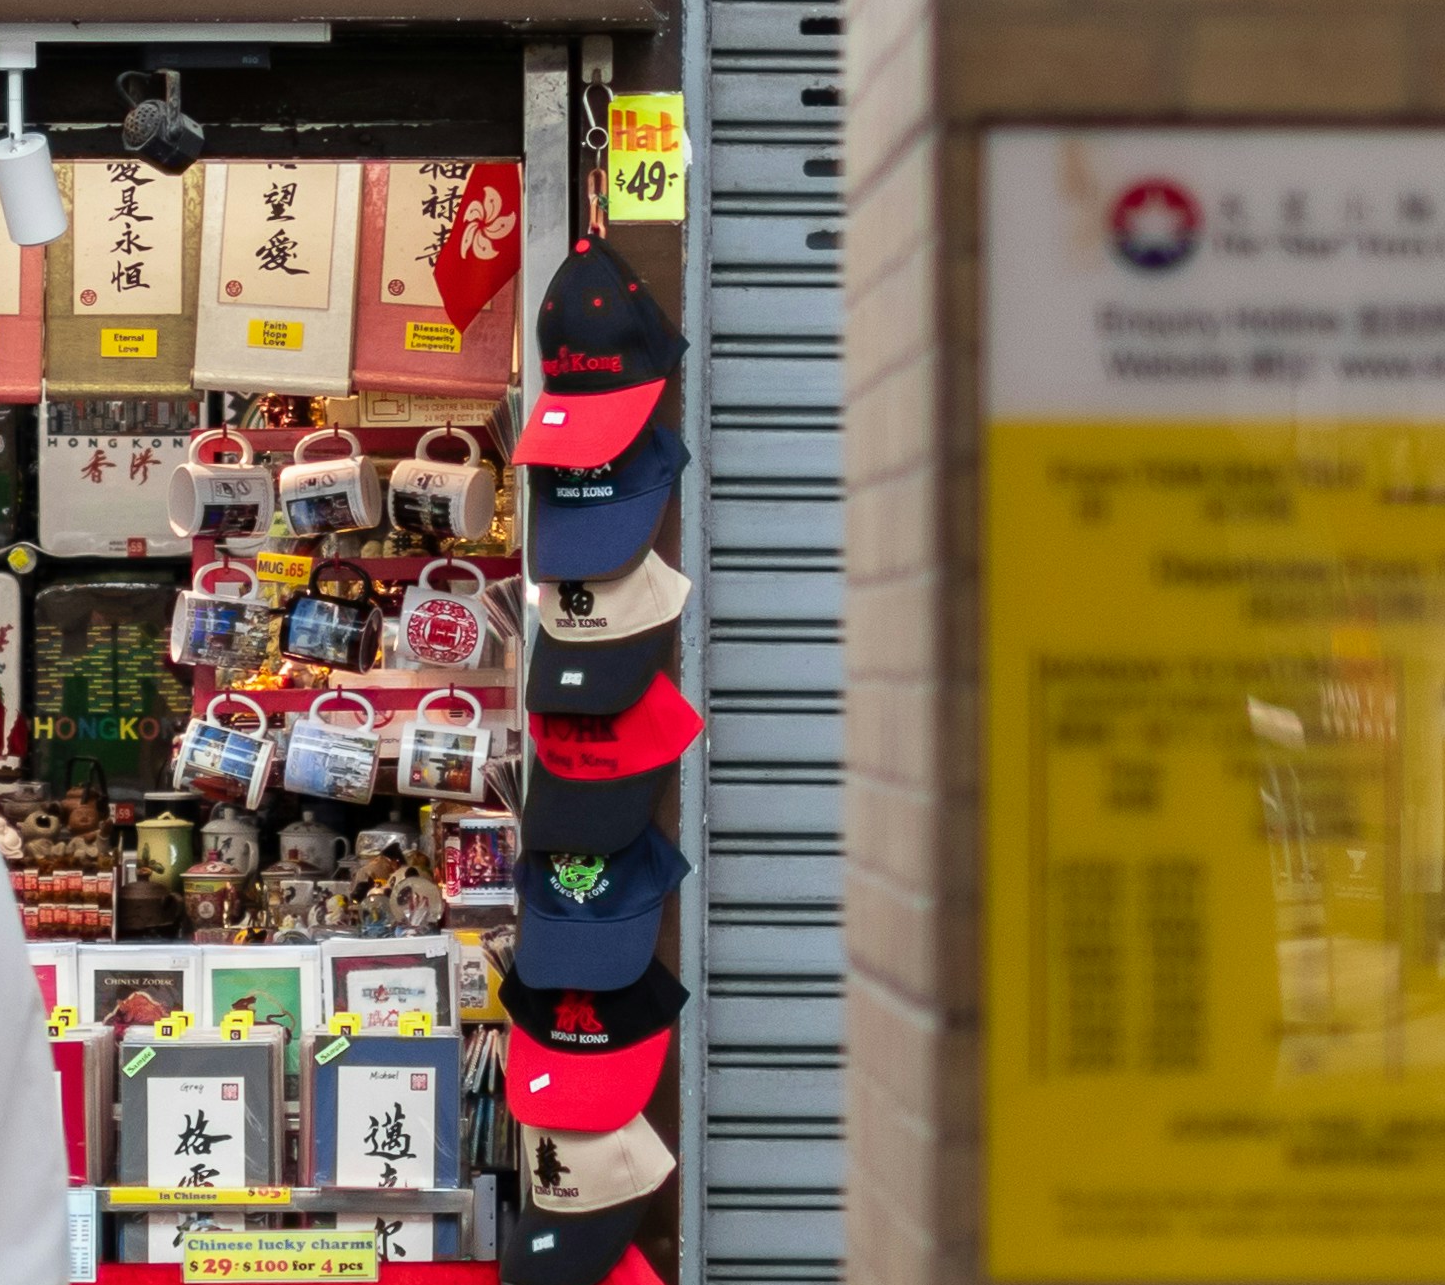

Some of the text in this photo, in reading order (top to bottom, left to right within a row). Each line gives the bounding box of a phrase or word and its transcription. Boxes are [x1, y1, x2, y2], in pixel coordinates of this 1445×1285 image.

[611, 109, 680, 153] Hat
[256, 162, 310, 276] 望愛
[263, 321, 288, 331] Faith
[413, 324, 455, 335] Blessing
[113, 333, 145, 342] Eternal
[262, 330, 287, 340] Hope
[412, 333, 455, 343] Prosperity
[262, 338, 286, 347] Love
[410, 342, 456, 352] Longevity
[118, 345, 139, 353] Love
[570, 352, 623, 373] Kong
[47, 437, 184, 448] HONG KON
[81, 448, 162, 486] 香港
[556, 485, 614, 498] HONG KONG
[258, 560, 284, 575] MUG
[578, 617, 608, 628] KONG
[550, 875, 573, 898] HONG
[104, 977, 174, 986] CHINESE ZODIAC
[550, 1030, 609, 1044] HONG KONG
[125, 1049, 153, 1075] Sample
[369, 1070, 399, 1080] Michael
[159, 1191, 218, 1200] in Chinese
[187, 1238, 373, 1253] Chinese lucky charms
[242, 1260, 289, 1272] $100
[292, 1260, 315, 1271] for
[320, 1259, 333, 1273] 4
[338, 1261, 363, 1273] pcs
